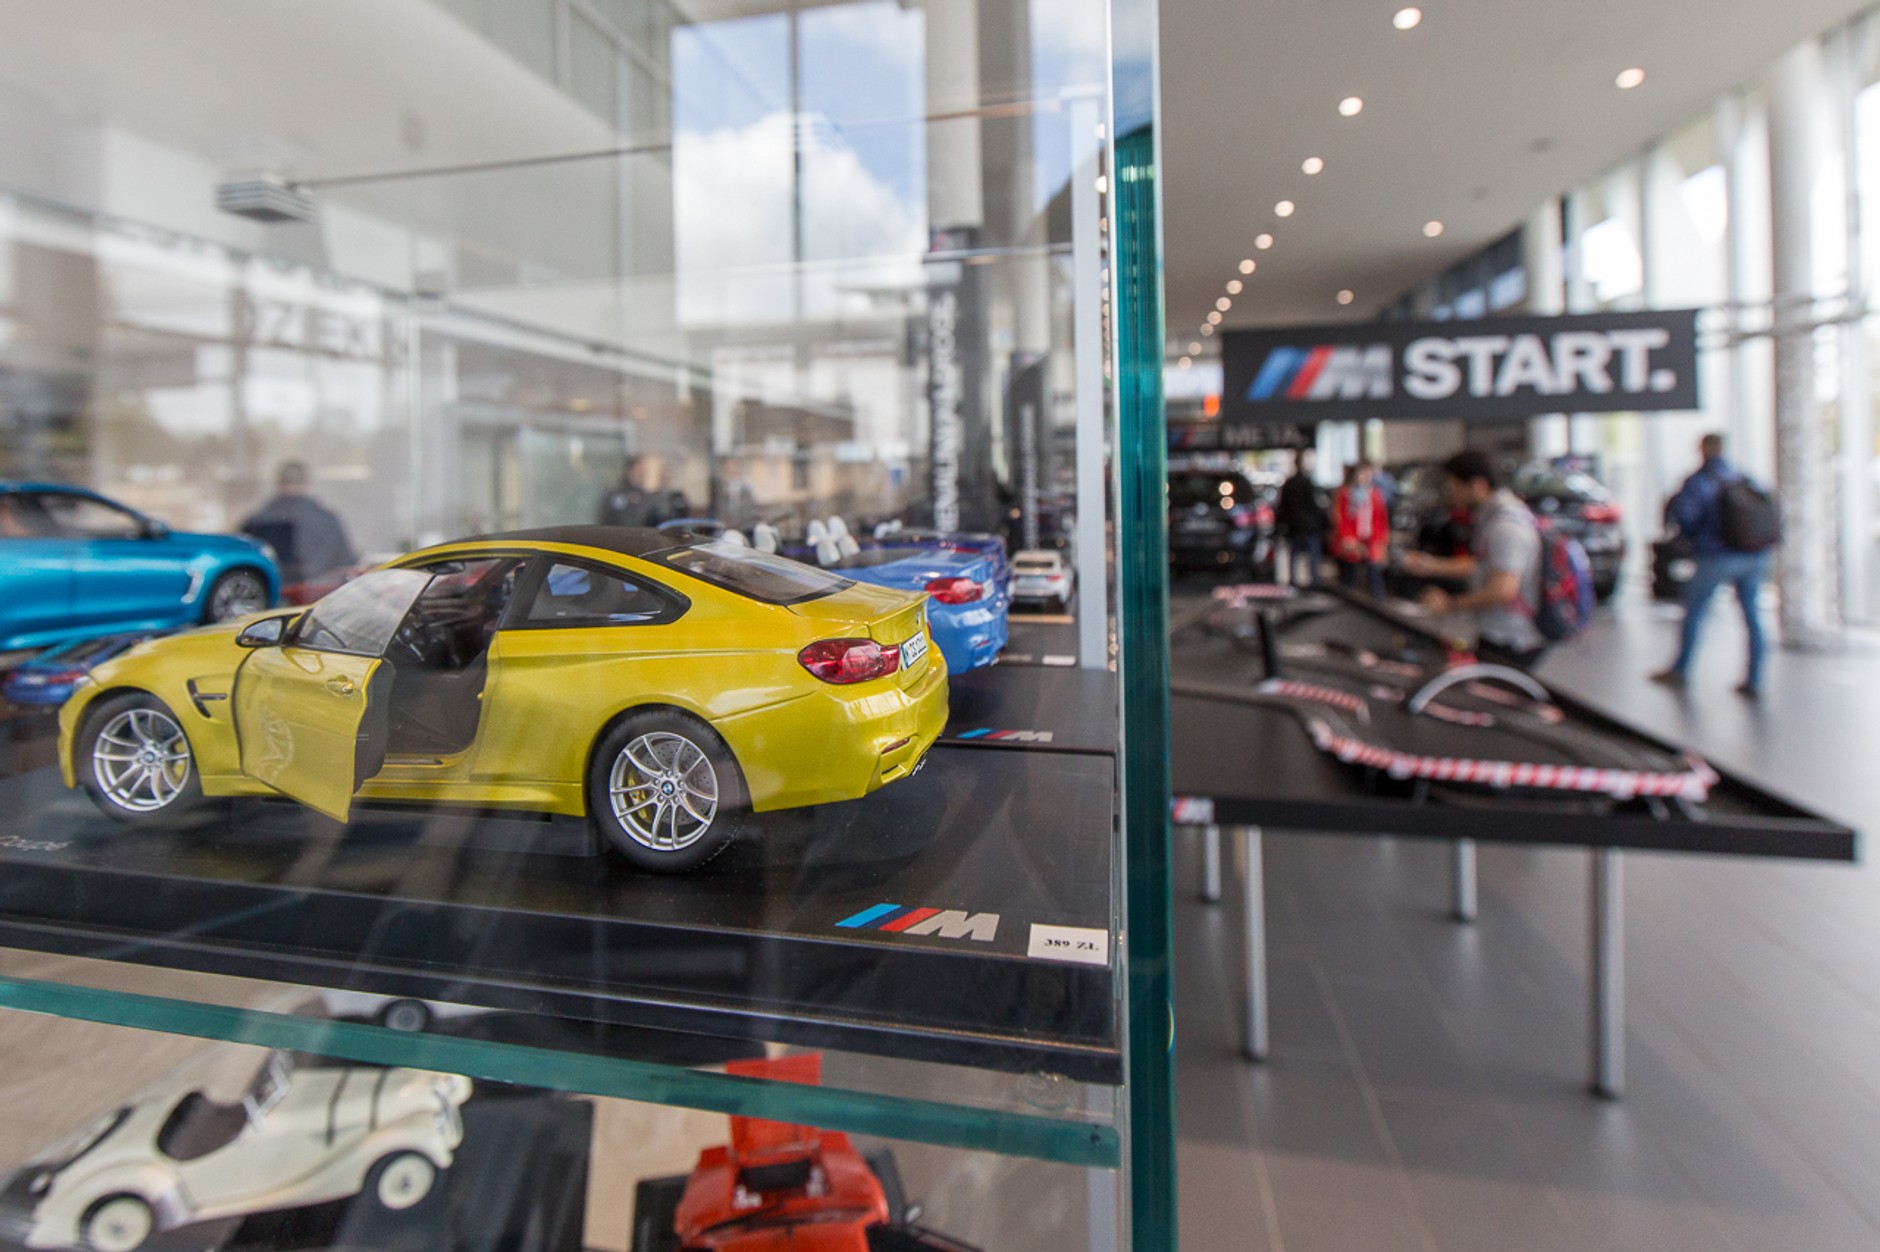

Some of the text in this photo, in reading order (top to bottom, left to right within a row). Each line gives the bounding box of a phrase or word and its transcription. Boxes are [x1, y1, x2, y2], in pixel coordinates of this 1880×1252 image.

[1403, 327, 1677, 398] START.
[903, 909, 1001, 942] M
[1043, 938, 1071, 948] 389
